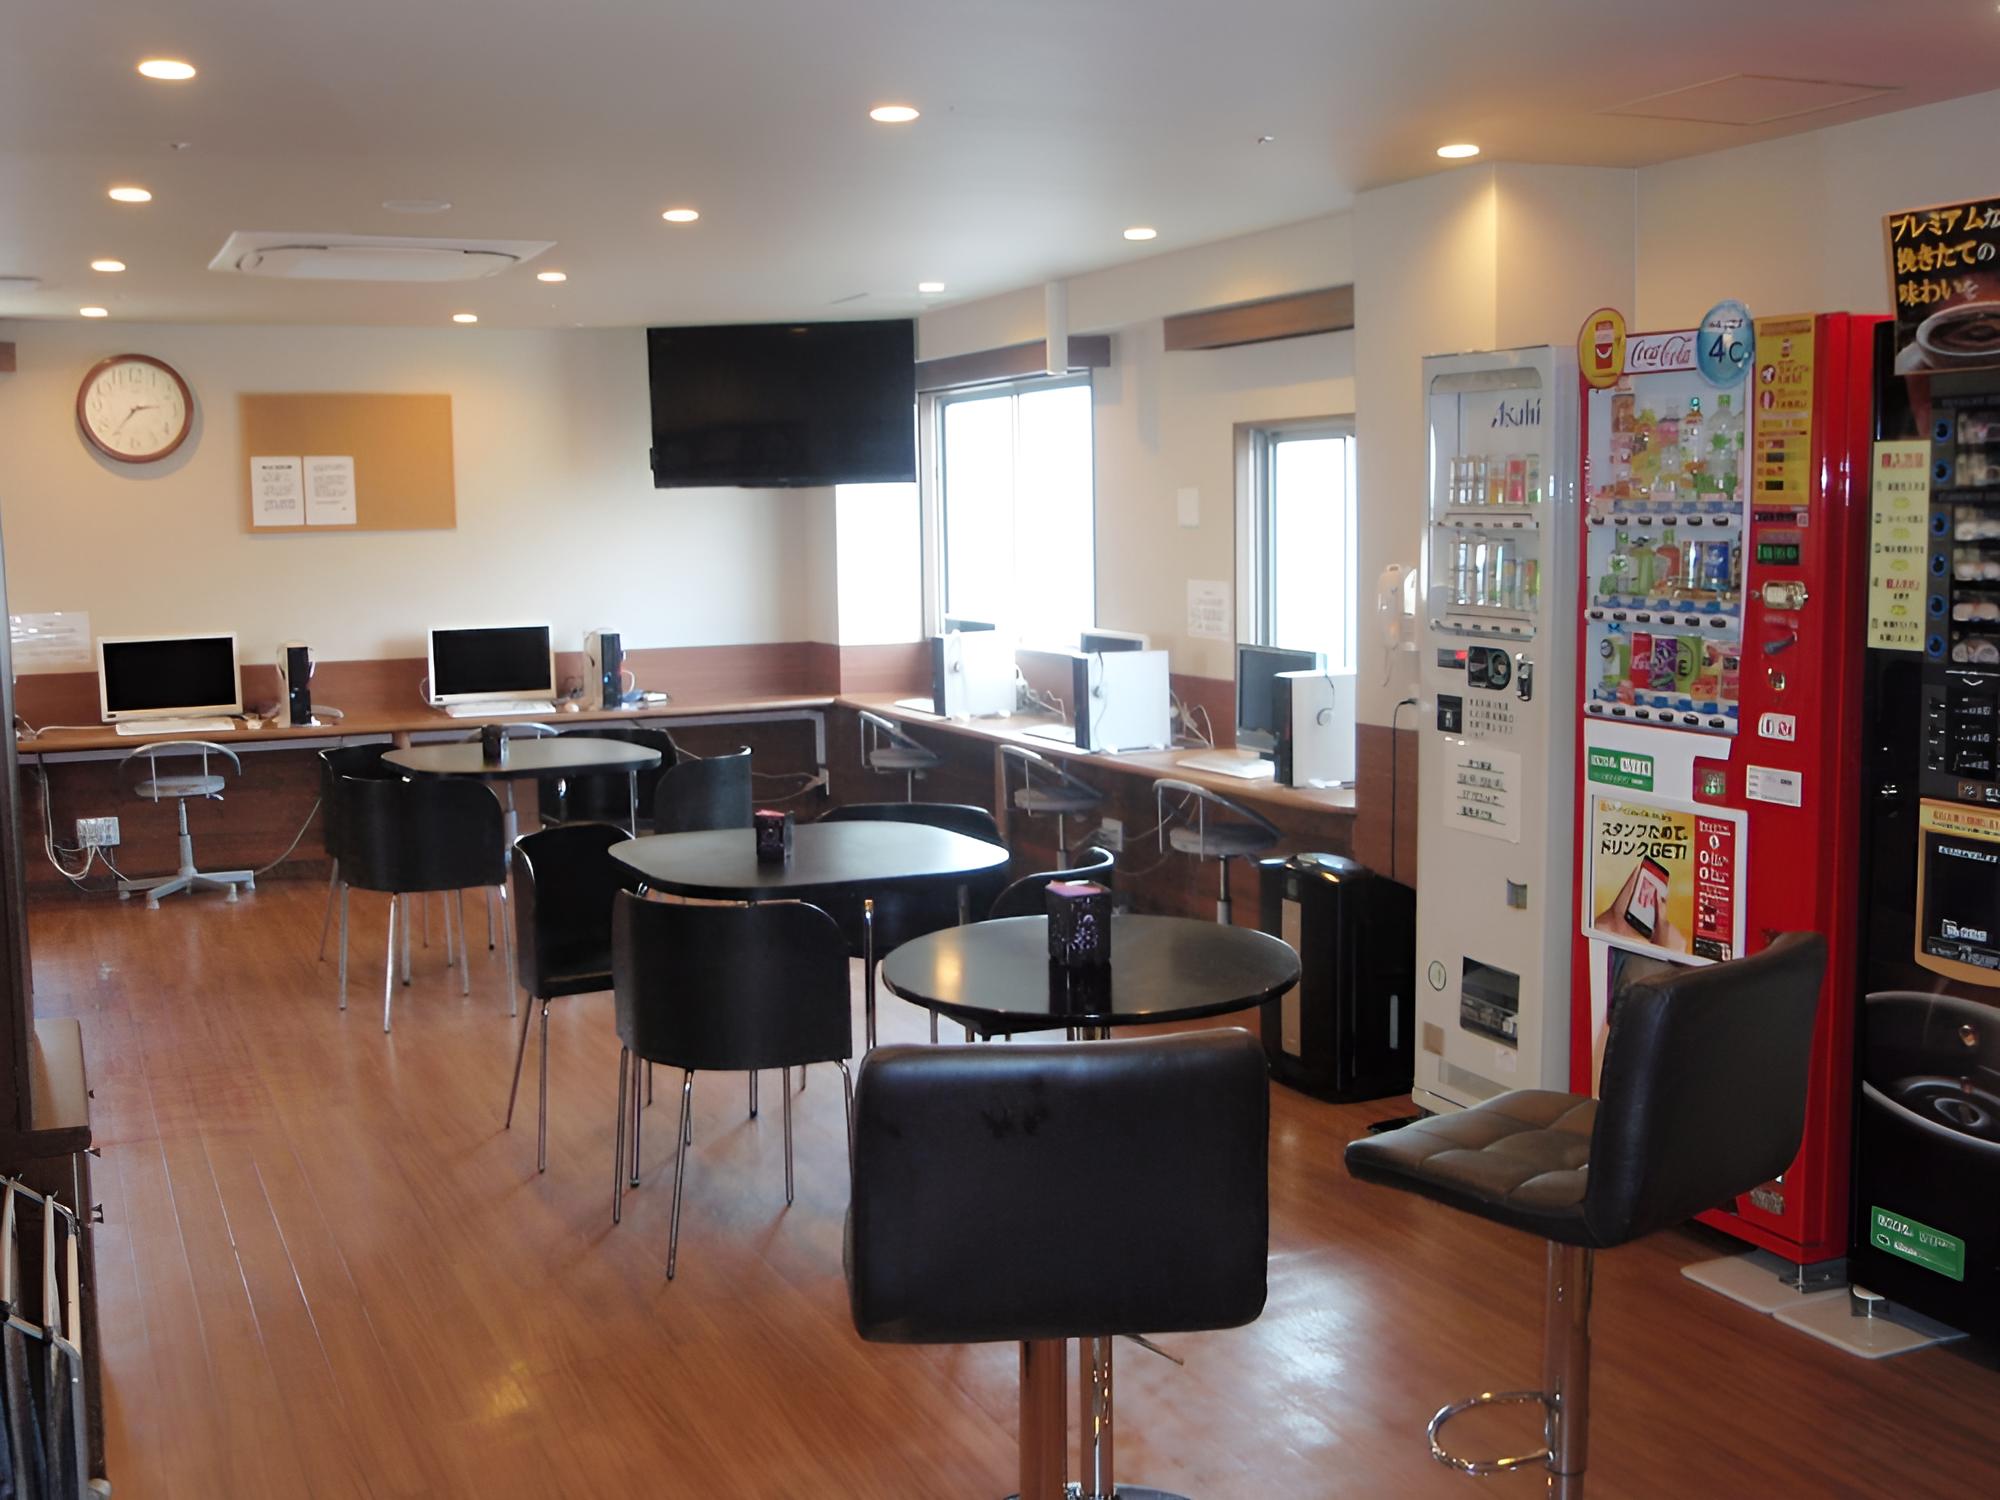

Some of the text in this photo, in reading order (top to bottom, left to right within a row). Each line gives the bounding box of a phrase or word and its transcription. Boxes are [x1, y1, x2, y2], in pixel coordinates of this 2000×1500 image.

[1897, 240, 1996, 274] 挽きたての
